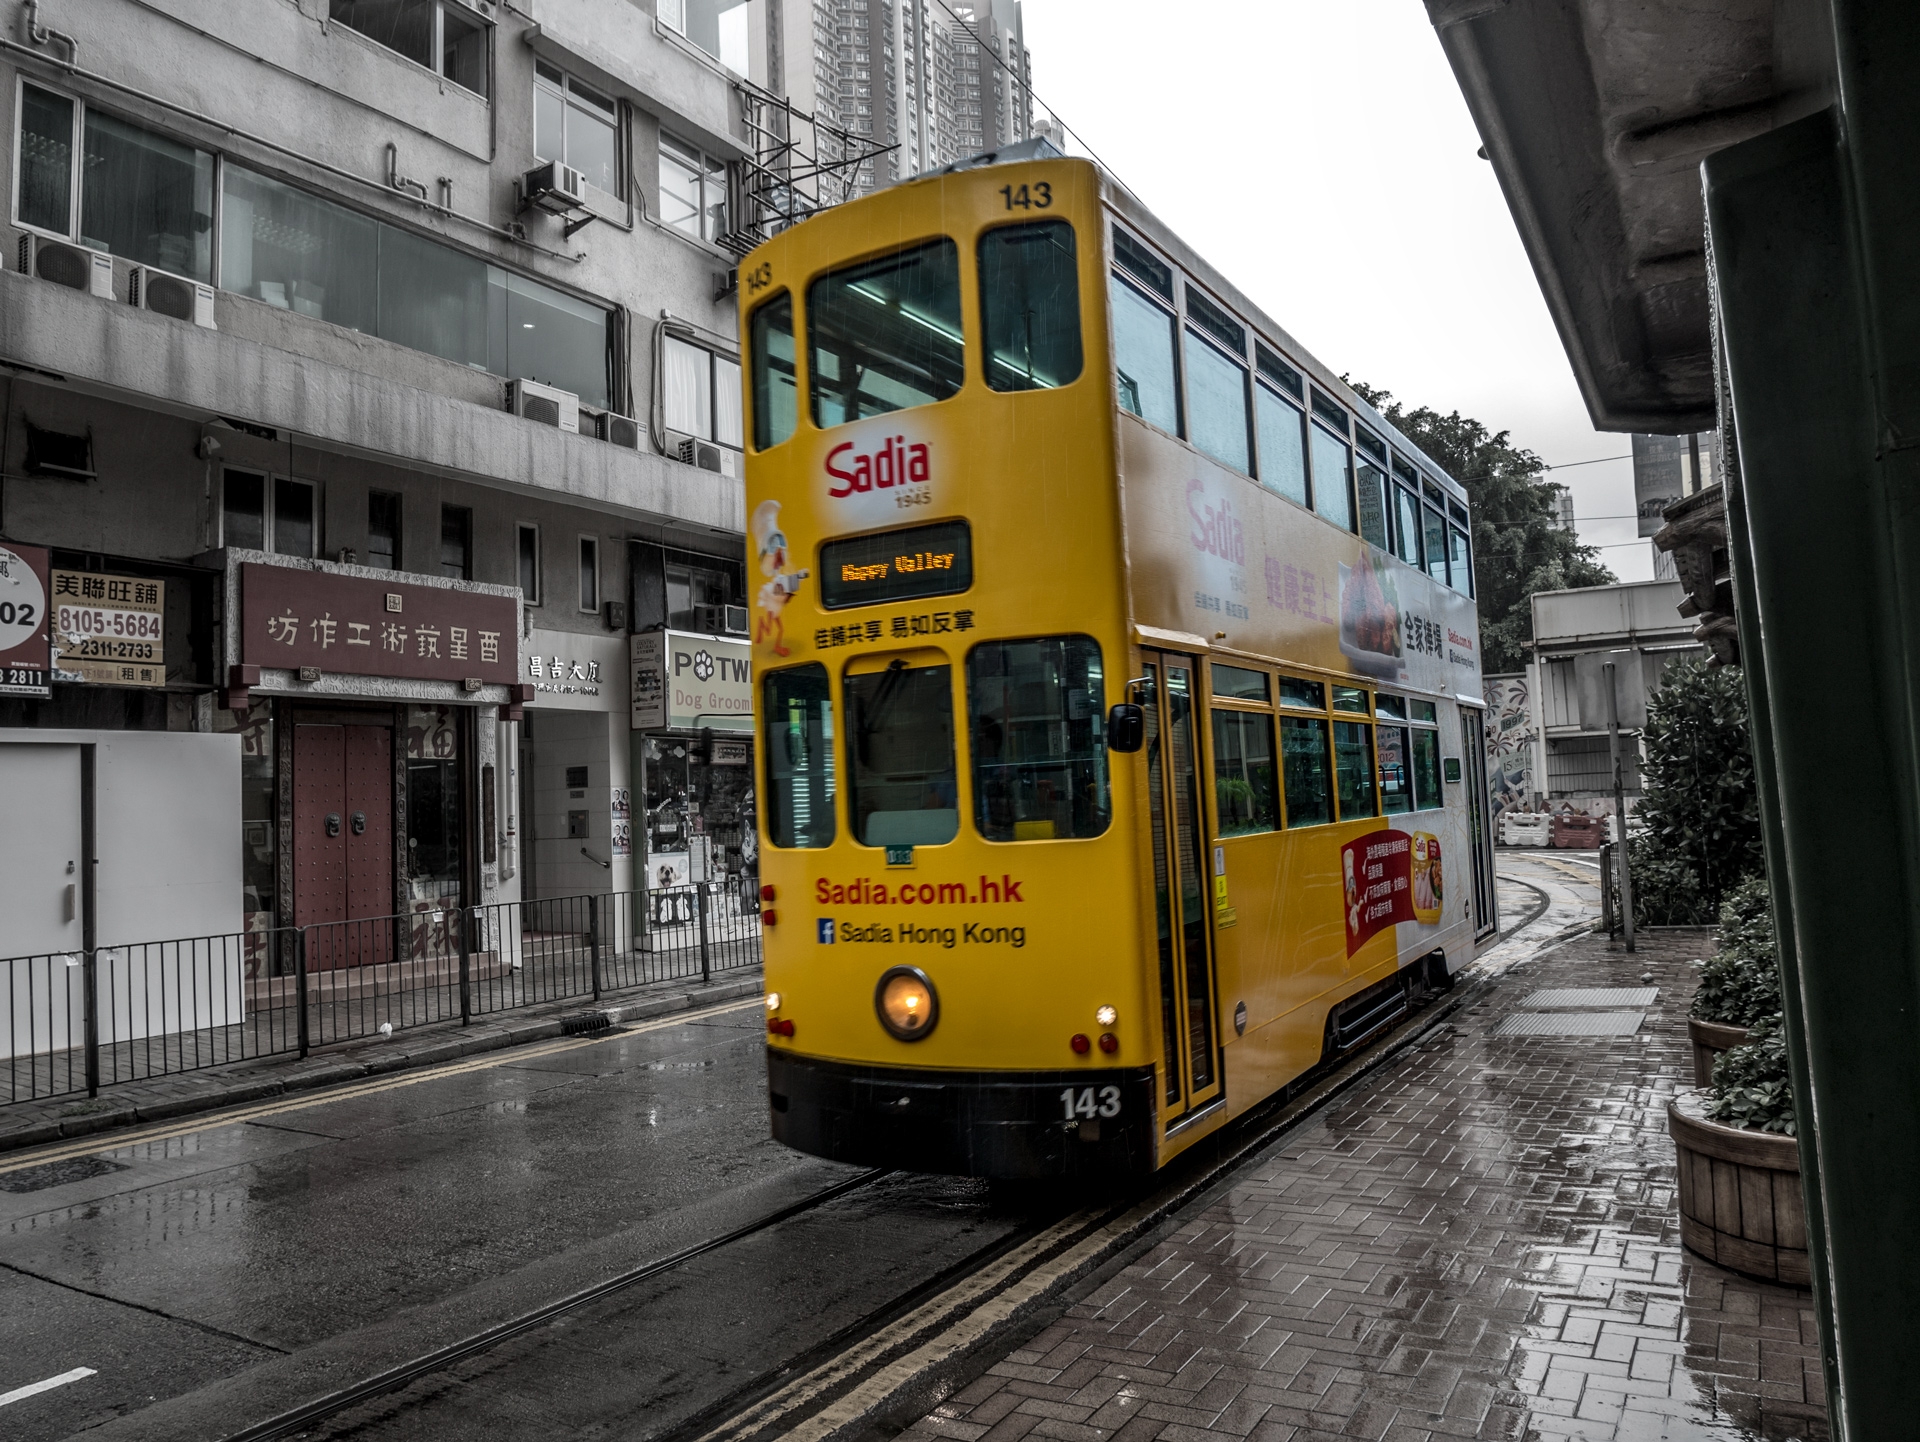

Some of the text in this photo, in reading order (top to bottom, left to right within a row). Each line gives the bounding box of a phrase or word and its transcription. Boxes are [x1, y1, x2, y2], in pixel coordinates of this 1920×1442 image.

[999, 181, 1053, 210] 143
[745, 262, 773, 295] 143
[824, 435, 931, 498] Sadia
[894, 491, 932, 509] 1945
[1185, 478, 1246, 567] Sadia
[842, 551, 956, 582] Happy Valley
[55, 574, 158, 605] 美聯旺舖
[815, 609, 976, 650] 佳餚共享 易如反掌
[1404, 611, 1443, 660] 全家捧場
[1447, 627, 1473, 651] Sadia.com.hk
[10, 669, 42, 685] 2811
[529, 655, 603, 684] 昌吉大廈
[675, 689, 703, 710] Dog
[1502, 713, 1523, 731] 1997
[816, 874, 1025, 905] Sadia.com.hk
[840, 922, 894, 944] Sadia
[898, 922, 956, 949] Hong
[962, 922, 1026, 948] Kong
[1060, 1084, 1122, 1120] 143
